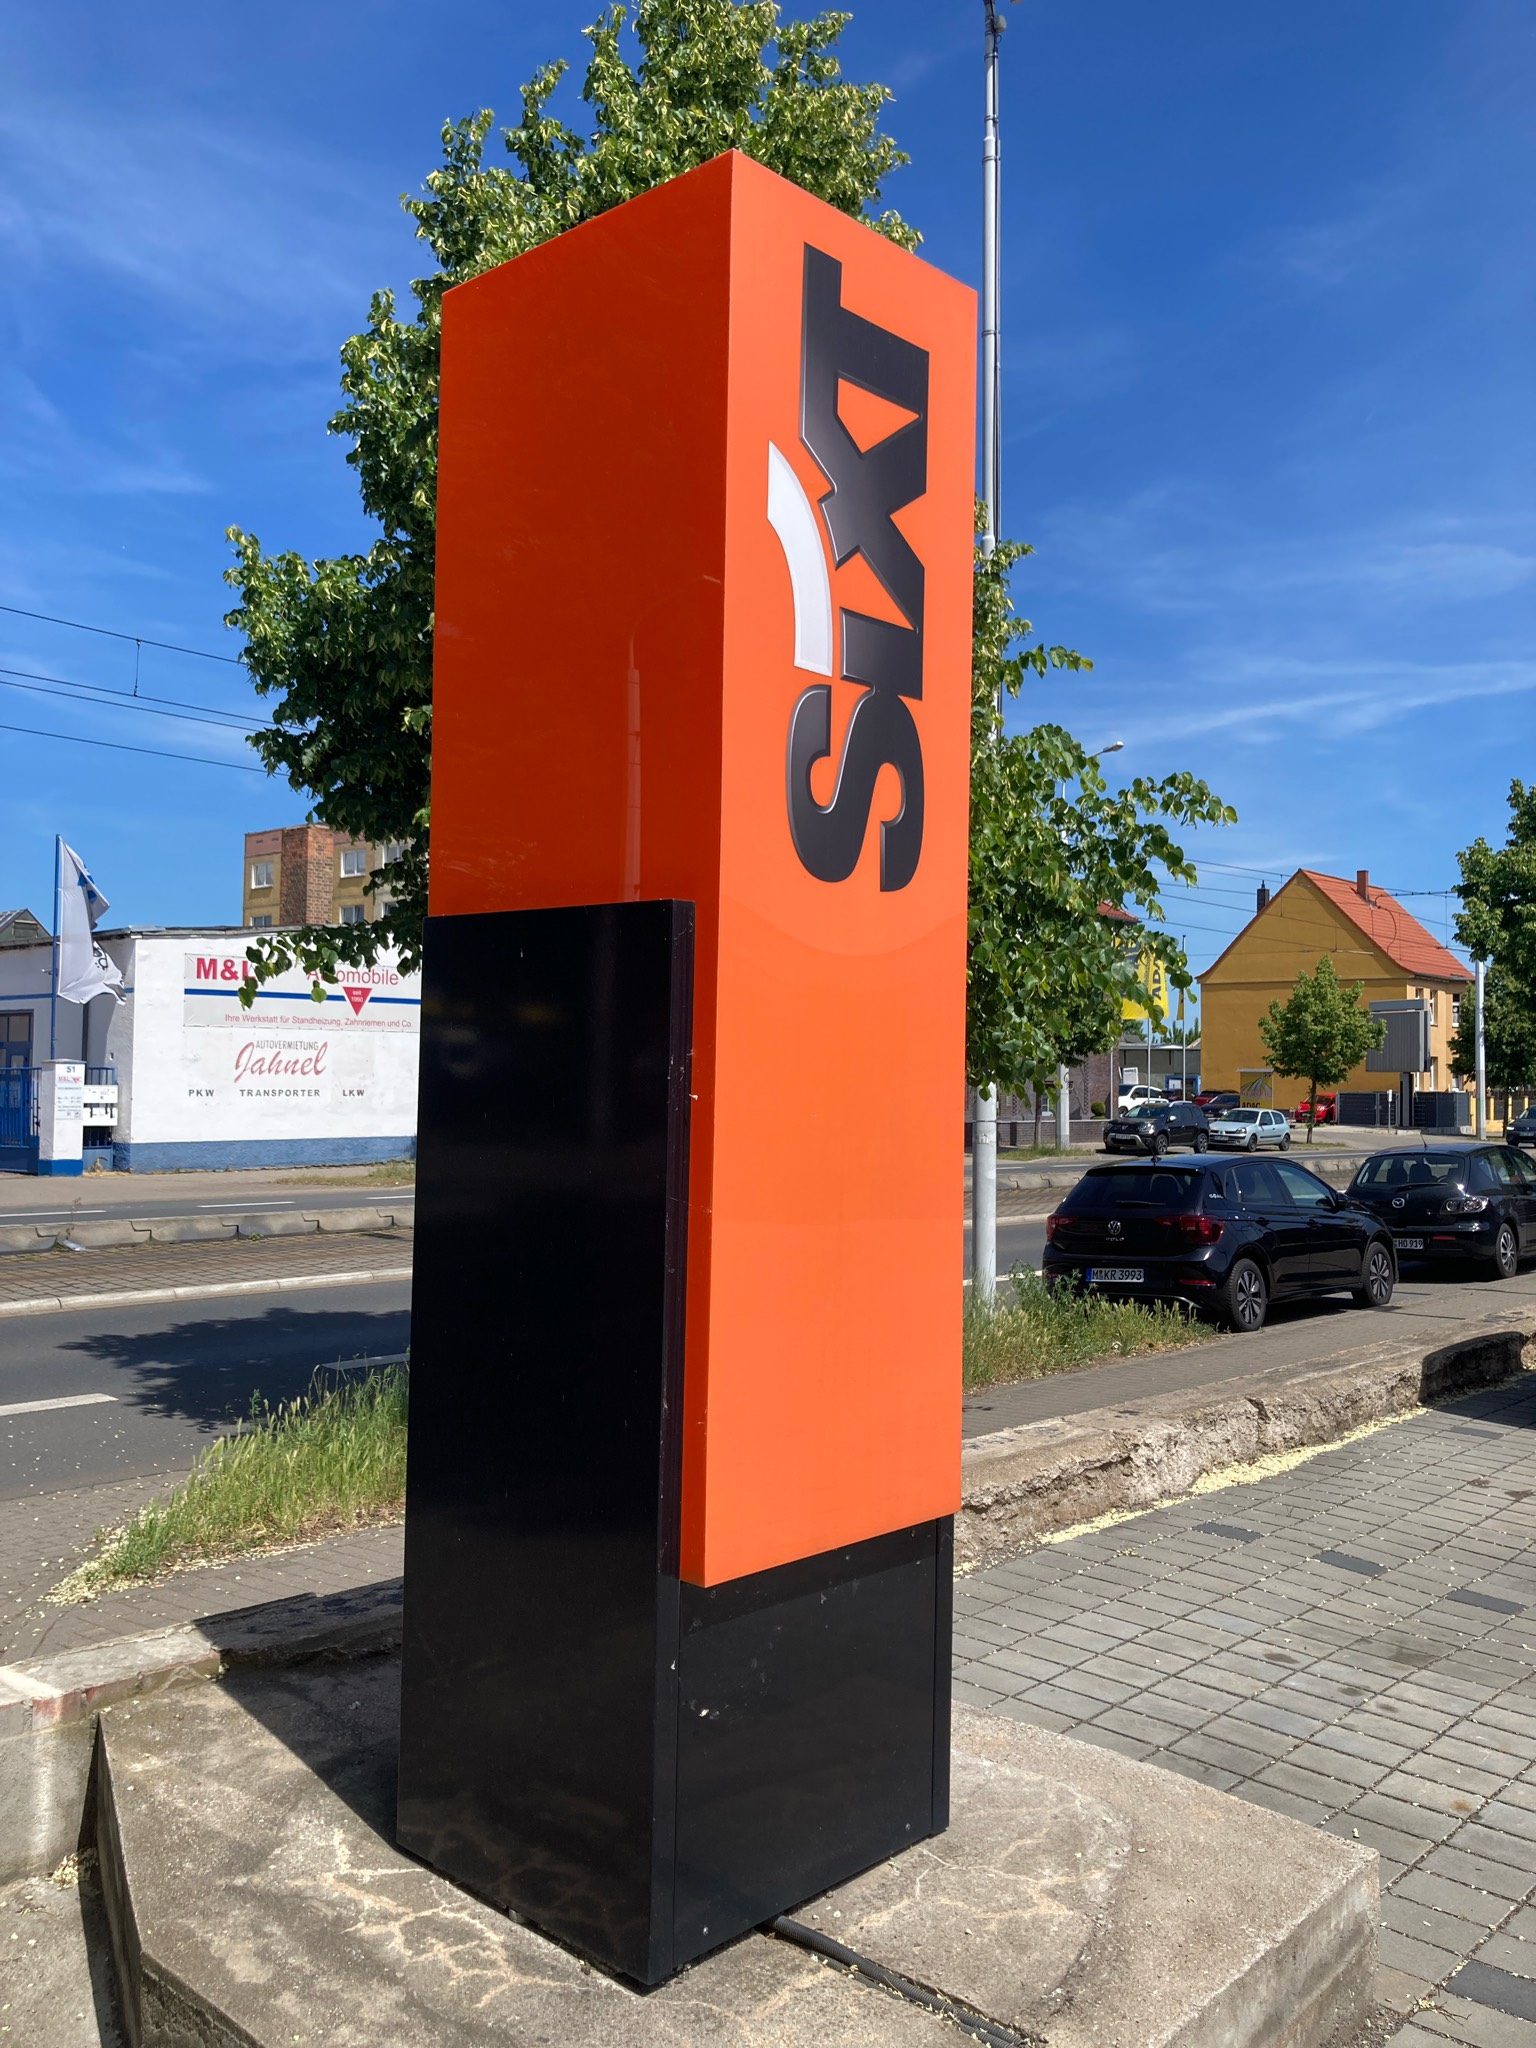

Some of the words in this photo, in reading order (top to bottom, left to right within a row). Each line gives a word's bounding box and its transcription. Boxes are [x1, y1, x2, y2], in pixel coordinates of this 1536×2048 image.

[768, 241, 929, 892] SIXT
[307, 969, 399, 985] Aomobile
[225, 1014, 240, 1023] Ihre
[242, 1014, 278, 1024] Werkstatt
[280, 1015, 290, 1024] für
[345, 1018, 386, 1027] Zahnriemen
[387, 1019, 400, 1028] und
[402, 1019, 414, 1028] Co.
[255, 1040, 319, 1051] AUTOVERMIETUNG
[234, 1041, 328, 1083] Jahnel
[188, 1088, 215, 1097] PKW
[240, 1088, 321, 1097] TRANSPORTER
[342, 1089, 365, 1097] LKW
[1409, 1239, 1423, 1247] 919
[1118, 1269, 1143, 1281] 3993
